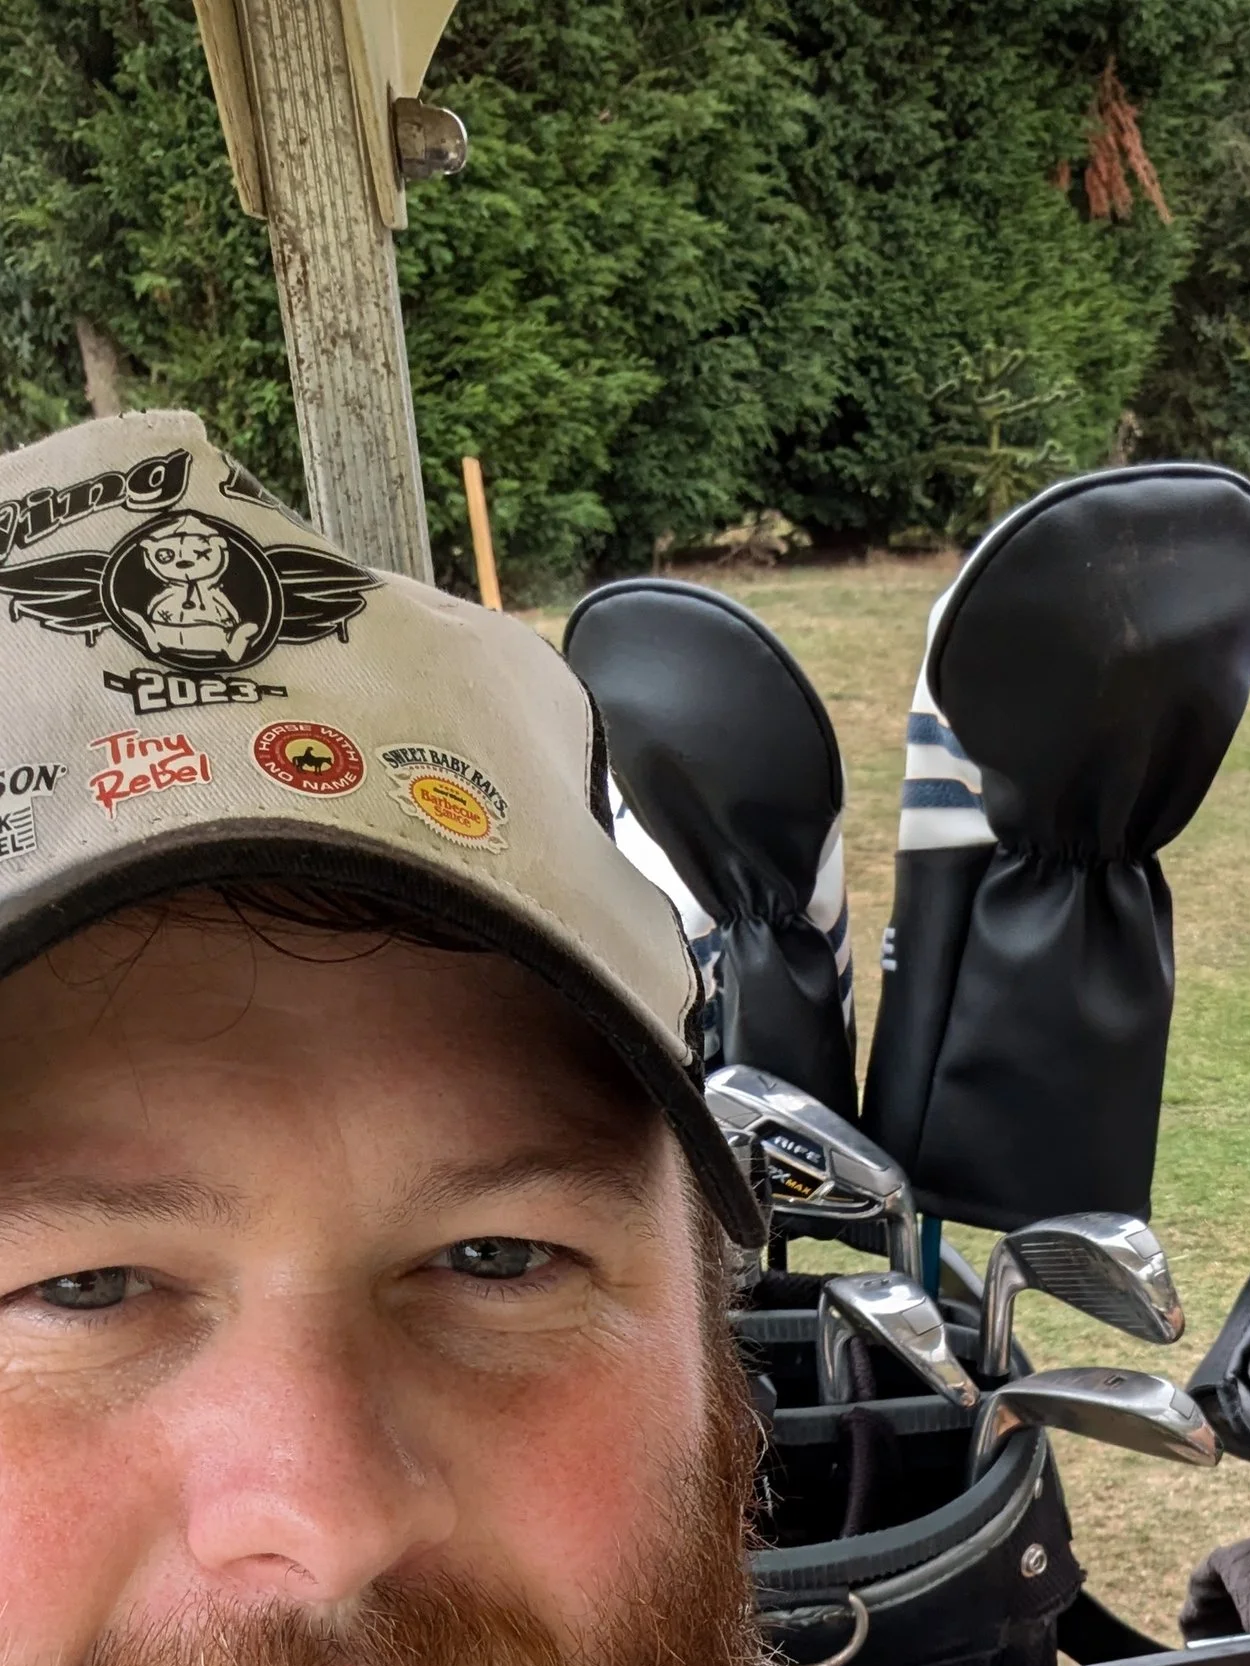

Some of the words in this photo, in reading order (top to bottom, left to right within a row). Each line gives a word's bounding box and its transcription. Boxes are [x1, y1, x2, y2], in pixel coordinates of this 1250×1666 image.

[90, 730, 195, 768] Tiny
[258, 724, 312, 752] HORSE
[320, 727, 359, 762] WITH
[264, 761, 294, 782] NO
[302, 771, 358, 792] NAME
[382, 747, 428, 769] SWEET
[428, 749, 470, 778] BABY
[90, 753, 211, 818] Rebel
